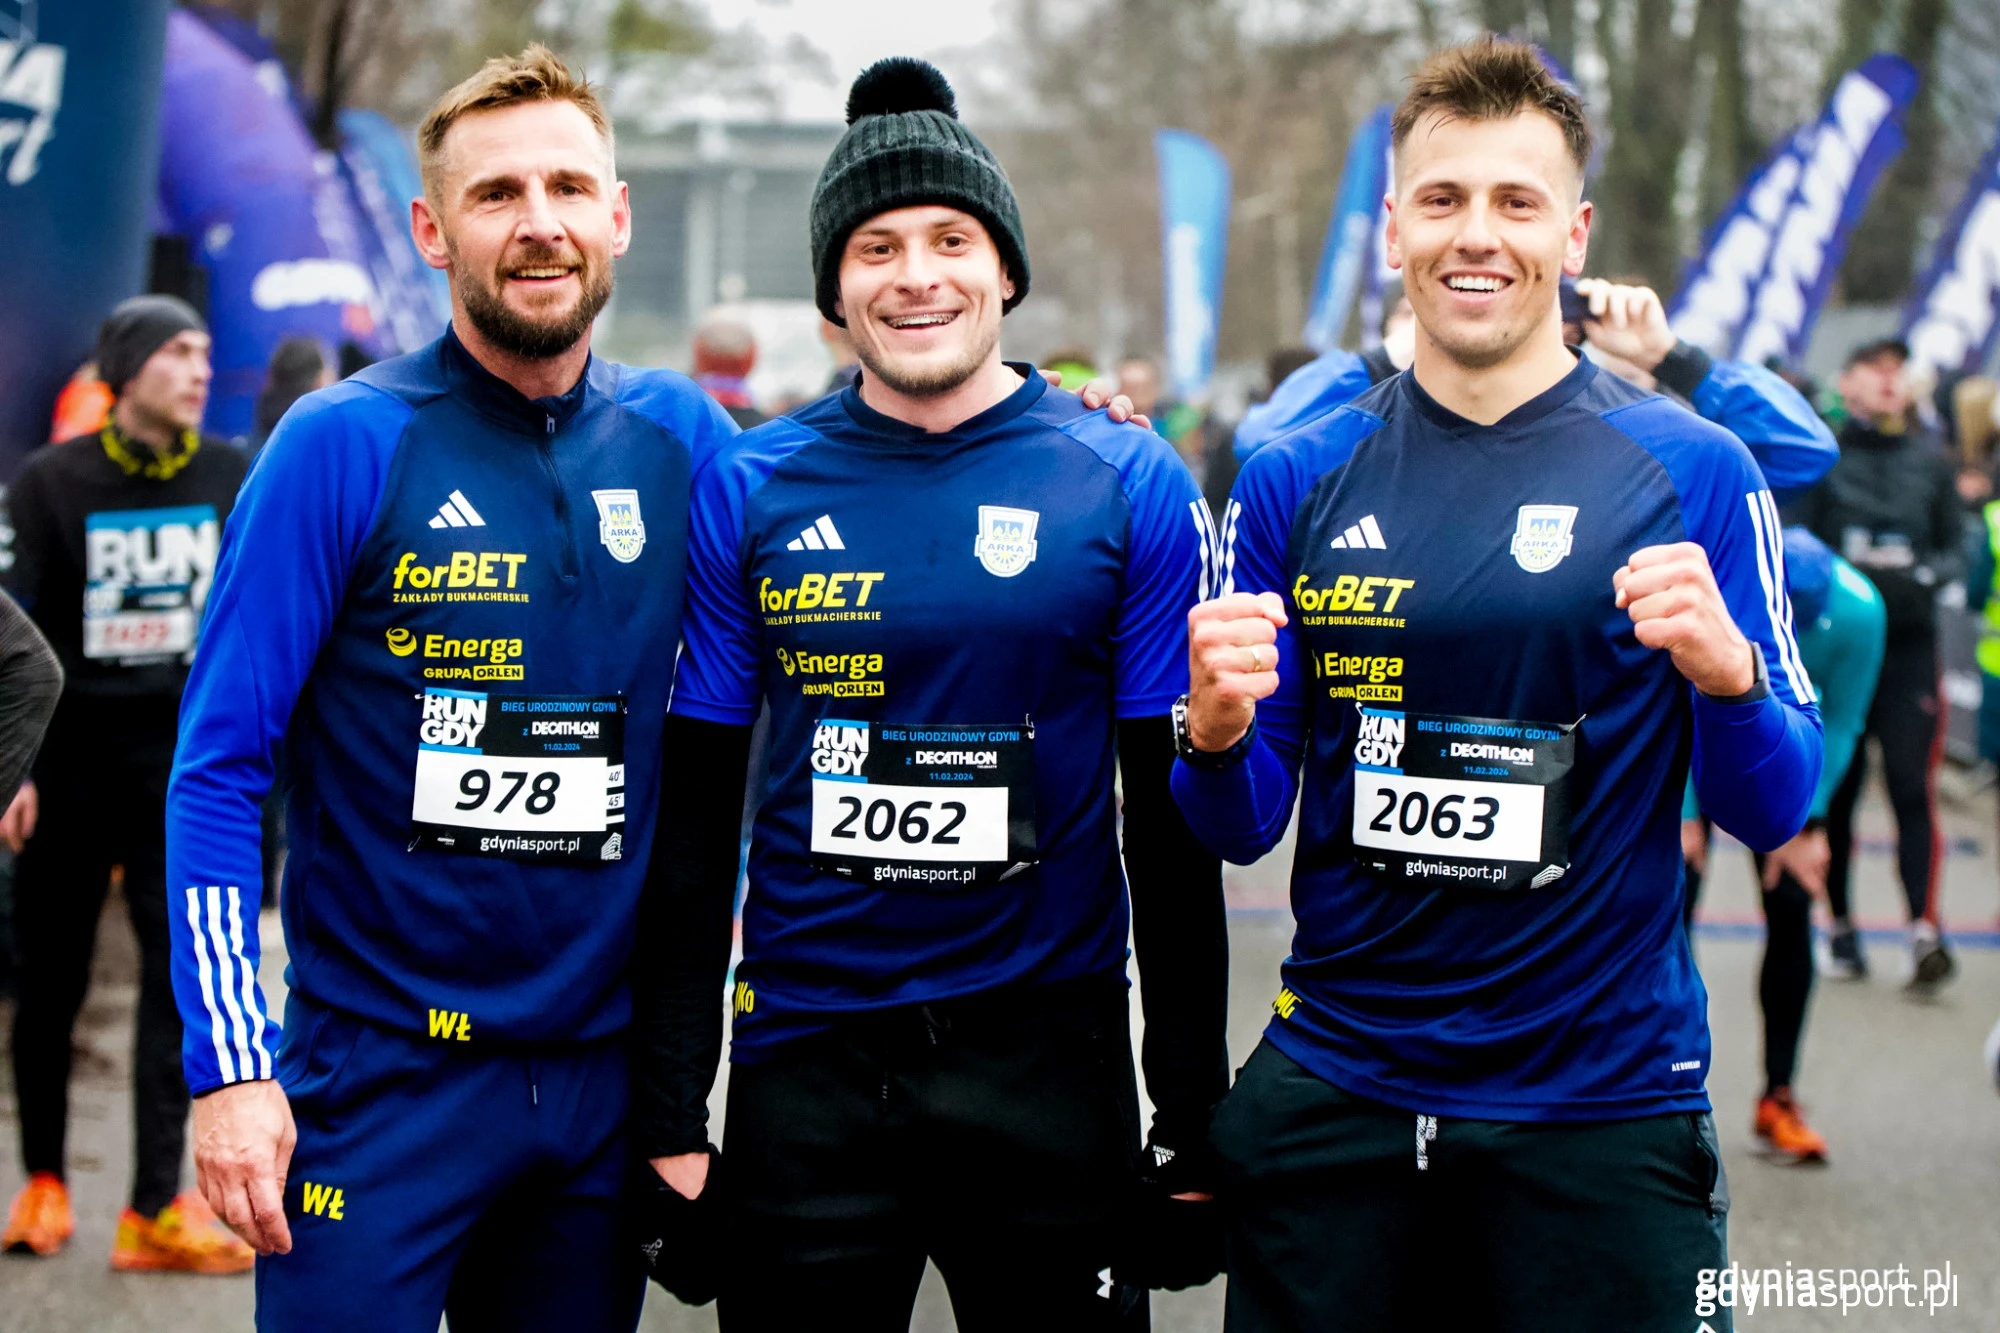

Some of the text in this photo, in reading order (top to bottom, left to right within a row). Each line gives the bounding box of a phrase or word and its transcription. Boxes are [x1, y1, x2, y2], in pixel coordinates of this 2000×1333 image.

[610, 528, 639, 537] ARKA
[87, 521, 218, 588] RUN
[987, 543, 1025, 553] ARKA
[1522, 540, 1559, 548] ARKA
[393, 551, 527, 589] forBET
[393, 592, 530, 603] ZAKŁADY BUKMACHERSKIE
[759, 572, 885, 613] forBET
[1292, 574, 1416, 613] forBET
[795, 611, 882, 623] BUKMACHERSKIE
[1328, 615, 1406, 629] BUKMACHERSKIE
[424, 634, 523, 664] Energa
[423, 667, 521, 679] GRUPA ORLEN
[795, 651, 884, 680] Energa
[1324, 652, 1404, 683] Energa
[836, 683, 881, 695] ORLEN
[1359, 687, 1399, 698] ORLEN
[422, 694, 488, 724] RUN
[501, 701, 617, 712] BIEG URODZINOWY GDYNI
[420, 719, 485, 748] GDY
[531, 721, 600, 736] DECATHLON
[812, 725, 870, 752] RUN
[882, 730, 1020, 742] BIEG URODZINOWY GDYNI
[1417, 720, 1561, 741] BIEG URODZINOWY GDYNI
[543, 743, 581, 751] 11.02.2024
[915, 750, 998, 765] DECATHLON
[1354, 740, 1405, 768] GDY
[1450, 742, 1534, 763] DECATHLON
[810, 749, 869, 776] GDY
[1463, 765, 1509, 776] 11.02.2024
[929, 772, 974, 781] 11.02.2024
[454, 768, 561, 816] 978
[830, 795, 967, 846] 2062
[1369, 787, 1501, 841] 2063
[480, 835, 580, 854] gdyniasport.pl
[873, 864, 976, 884] gdyniasport.pl
[1405, 859, 1507, 882] gdyniasport.pl
[428, 1008, 471, 1041] WŁ
[303, 1181, 344, 1221] WŁ
